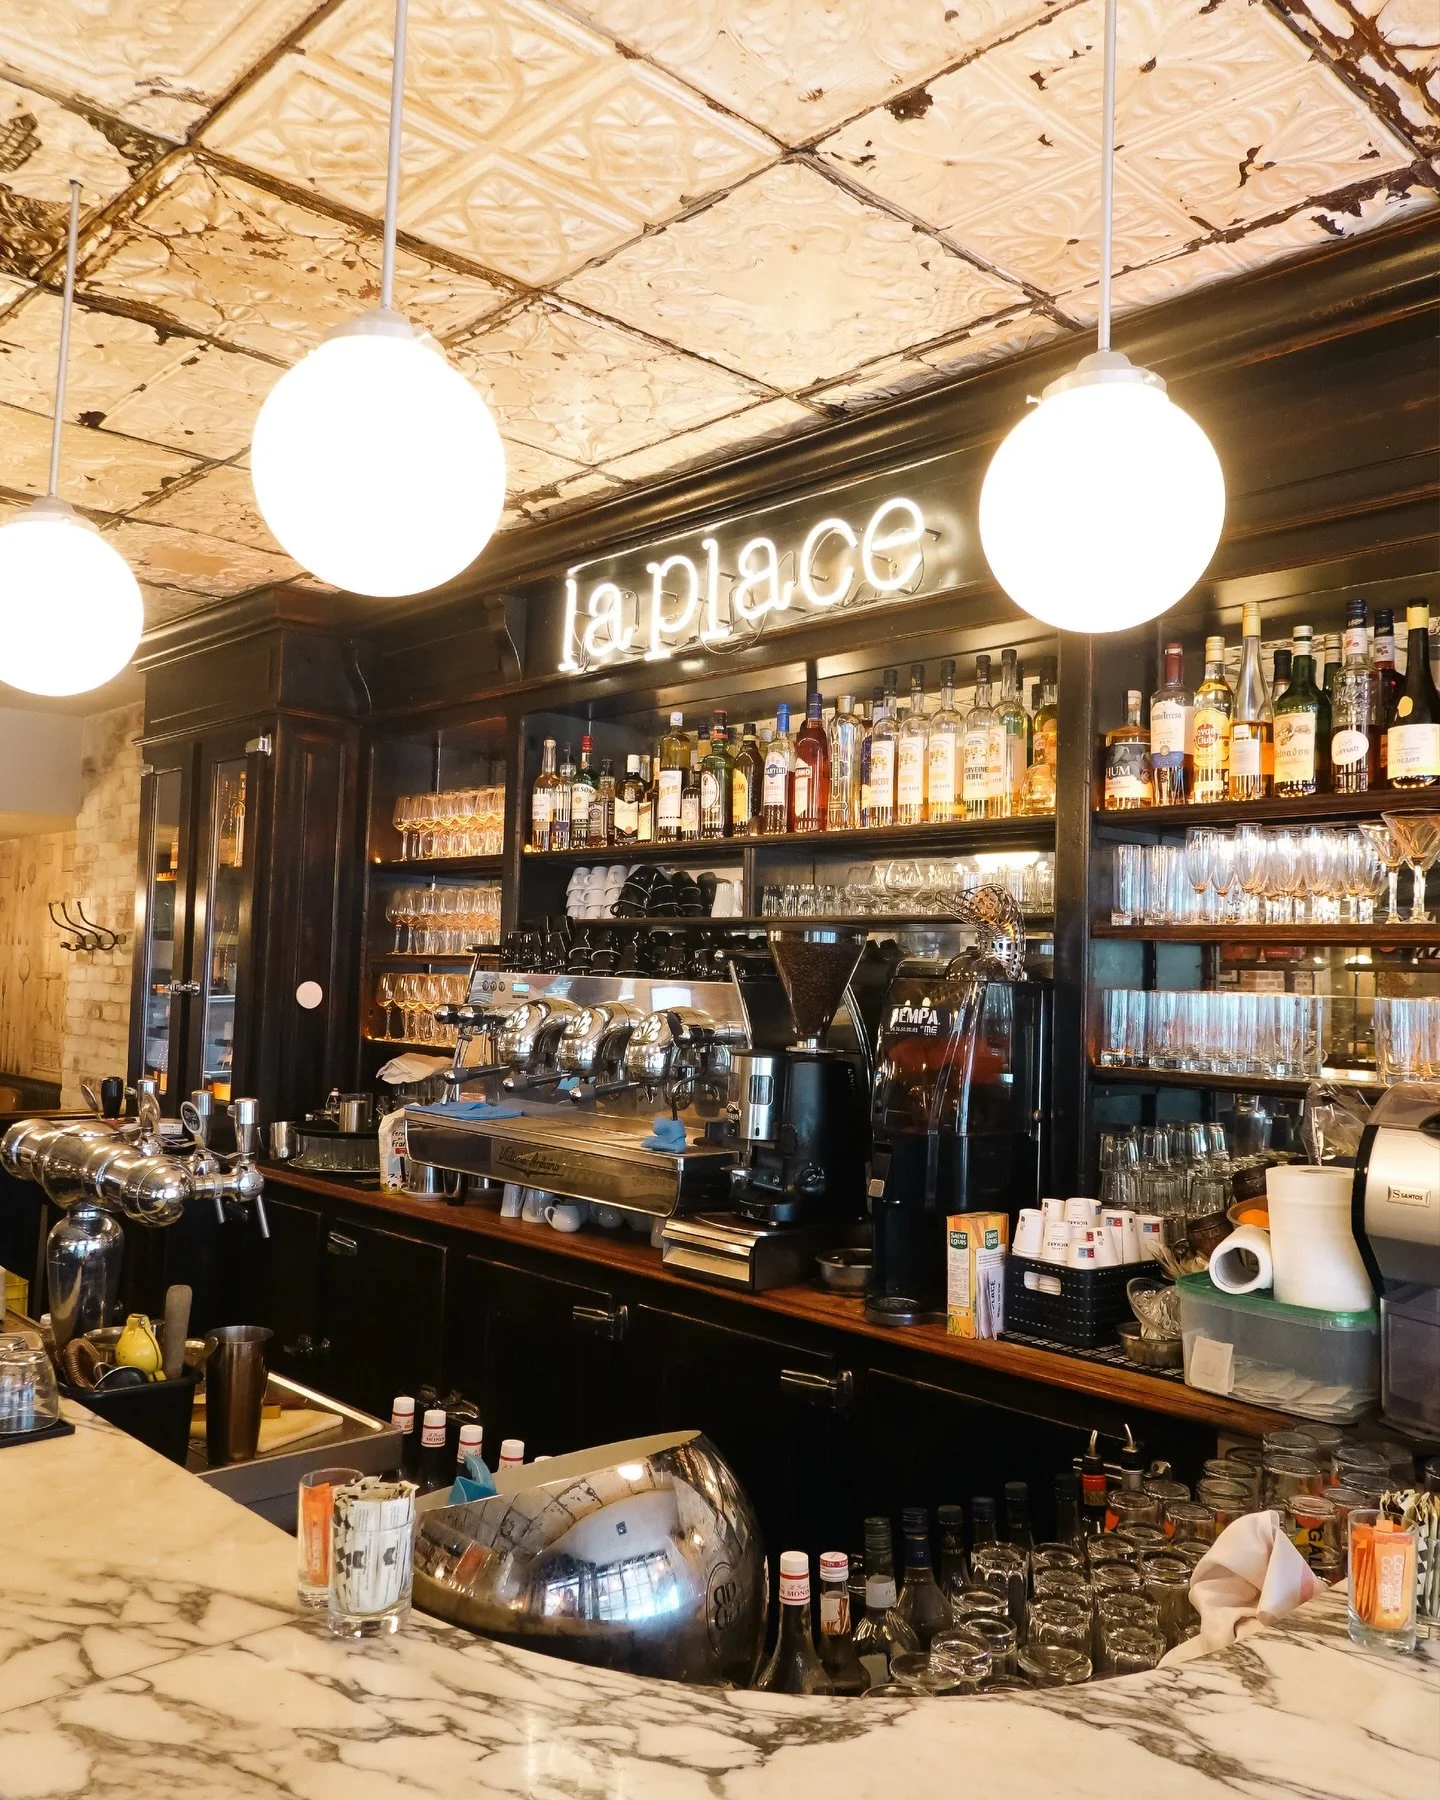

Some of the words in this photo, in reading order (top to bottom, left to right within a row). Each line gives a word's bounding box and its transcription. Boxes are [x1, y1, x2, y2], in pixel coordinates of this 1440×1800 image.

[559, 578, 634, 671] la
[646, 498, 924, 661] place
[965, 766, 989, 774] ERVEINE
[1400, 1192, 1423, 1201] SANTOS
[950, 1231, 967, 1240] SAINT
[985, 1231, 998, 1239] SAINT
[950, 1238, 967, 1246] LOUIS
